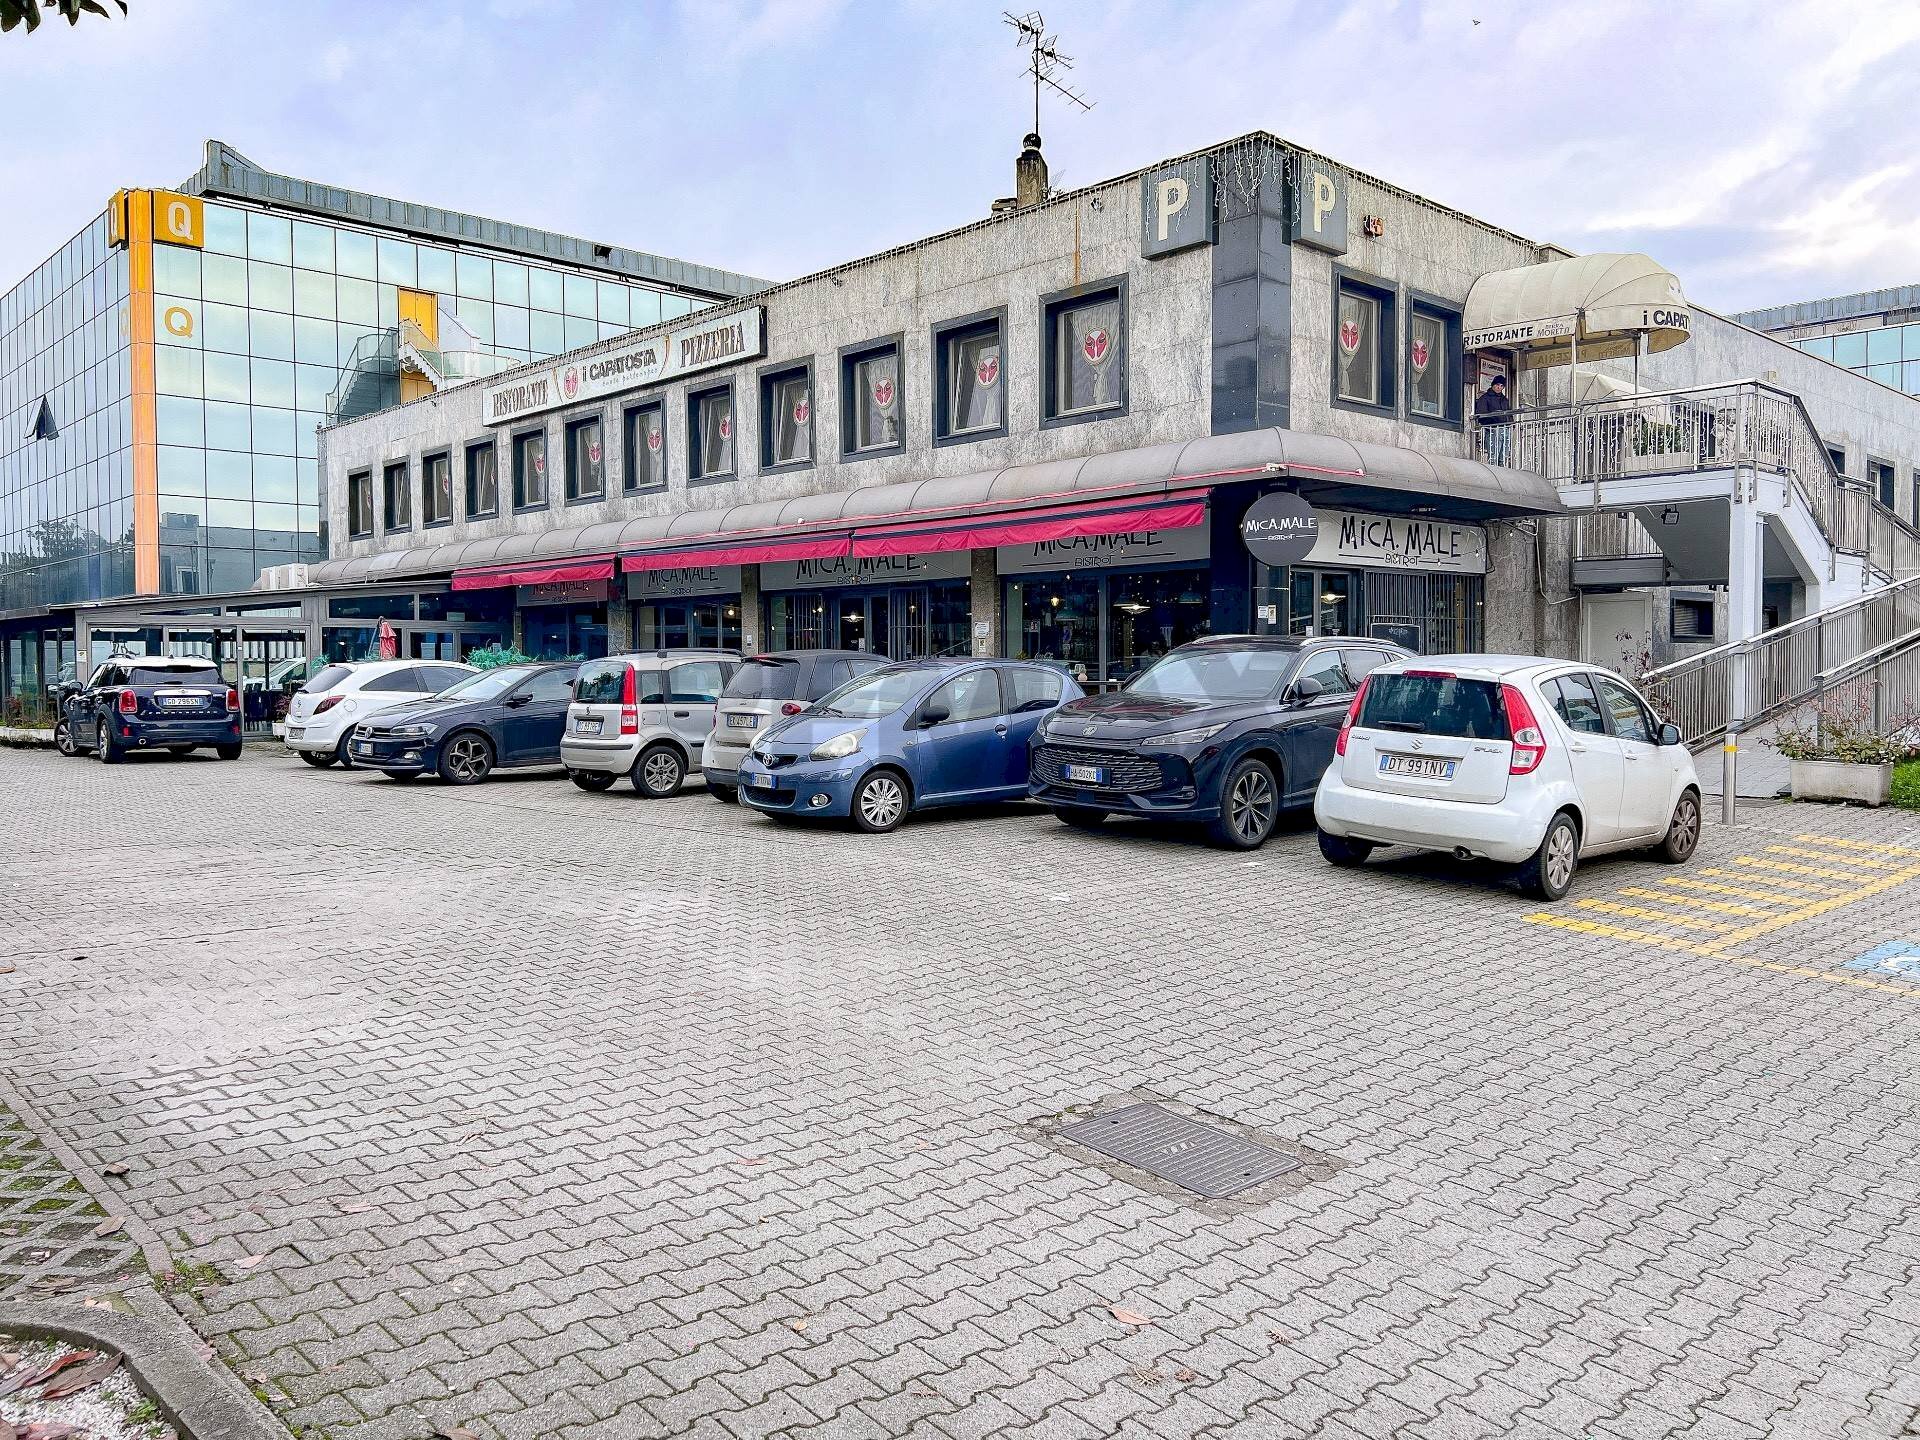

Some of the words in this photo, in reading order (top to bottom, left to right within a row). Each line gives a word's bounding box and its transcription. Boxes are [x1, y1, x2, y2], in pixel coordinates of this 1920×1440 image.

[1157, 177, 1189, 242] P
[1313, 172, 1335, 233] P
[167, 201, 194, 241] Q
[164, 306, 194, 338] Q
[1643, 310, 1648, 325] i
[1463, 326, 1534, 346] RISTORANTE
[492, 379, 549, 418] RISTORANTE
[680, 320, 746, 369] PIZZERIA
[1075, 555, 1116, 567] BISTROT
[1388, 757, 1403, 770] DT
[1407, 760, 1447, 776] 991NV
